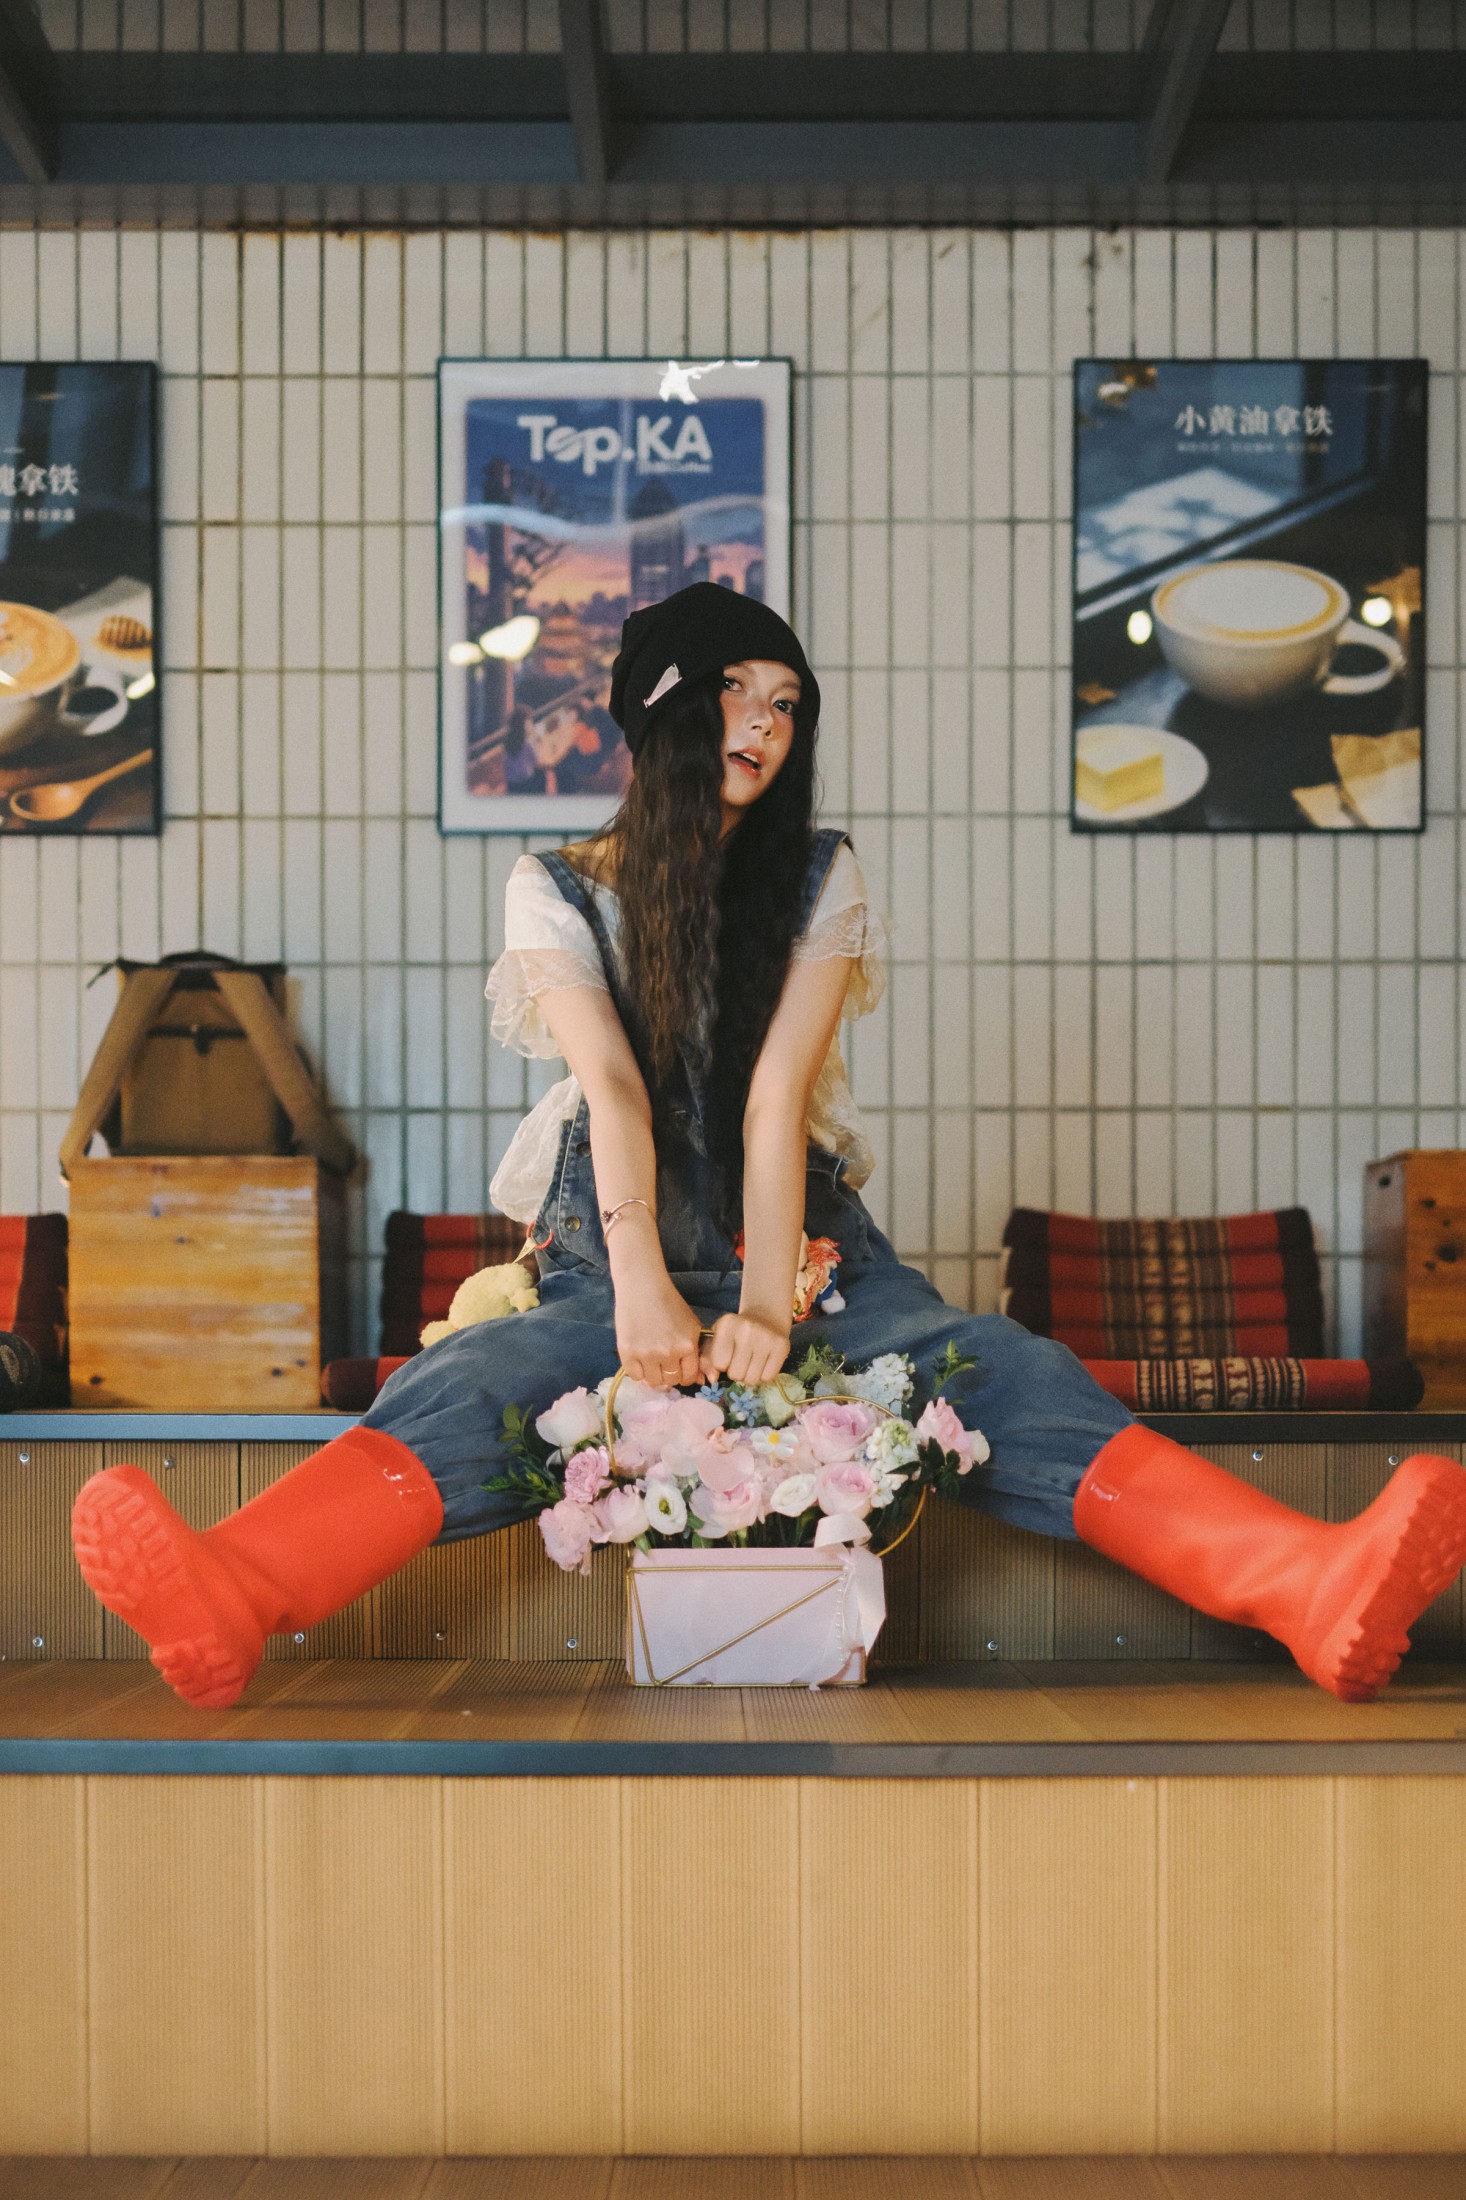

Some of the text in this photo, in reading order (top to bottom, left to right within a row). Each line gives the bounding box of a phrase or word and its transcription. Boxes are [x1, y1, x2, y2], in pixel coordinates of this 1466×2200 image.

[1174, 404, 1333, 436] 小黄油拿铁
